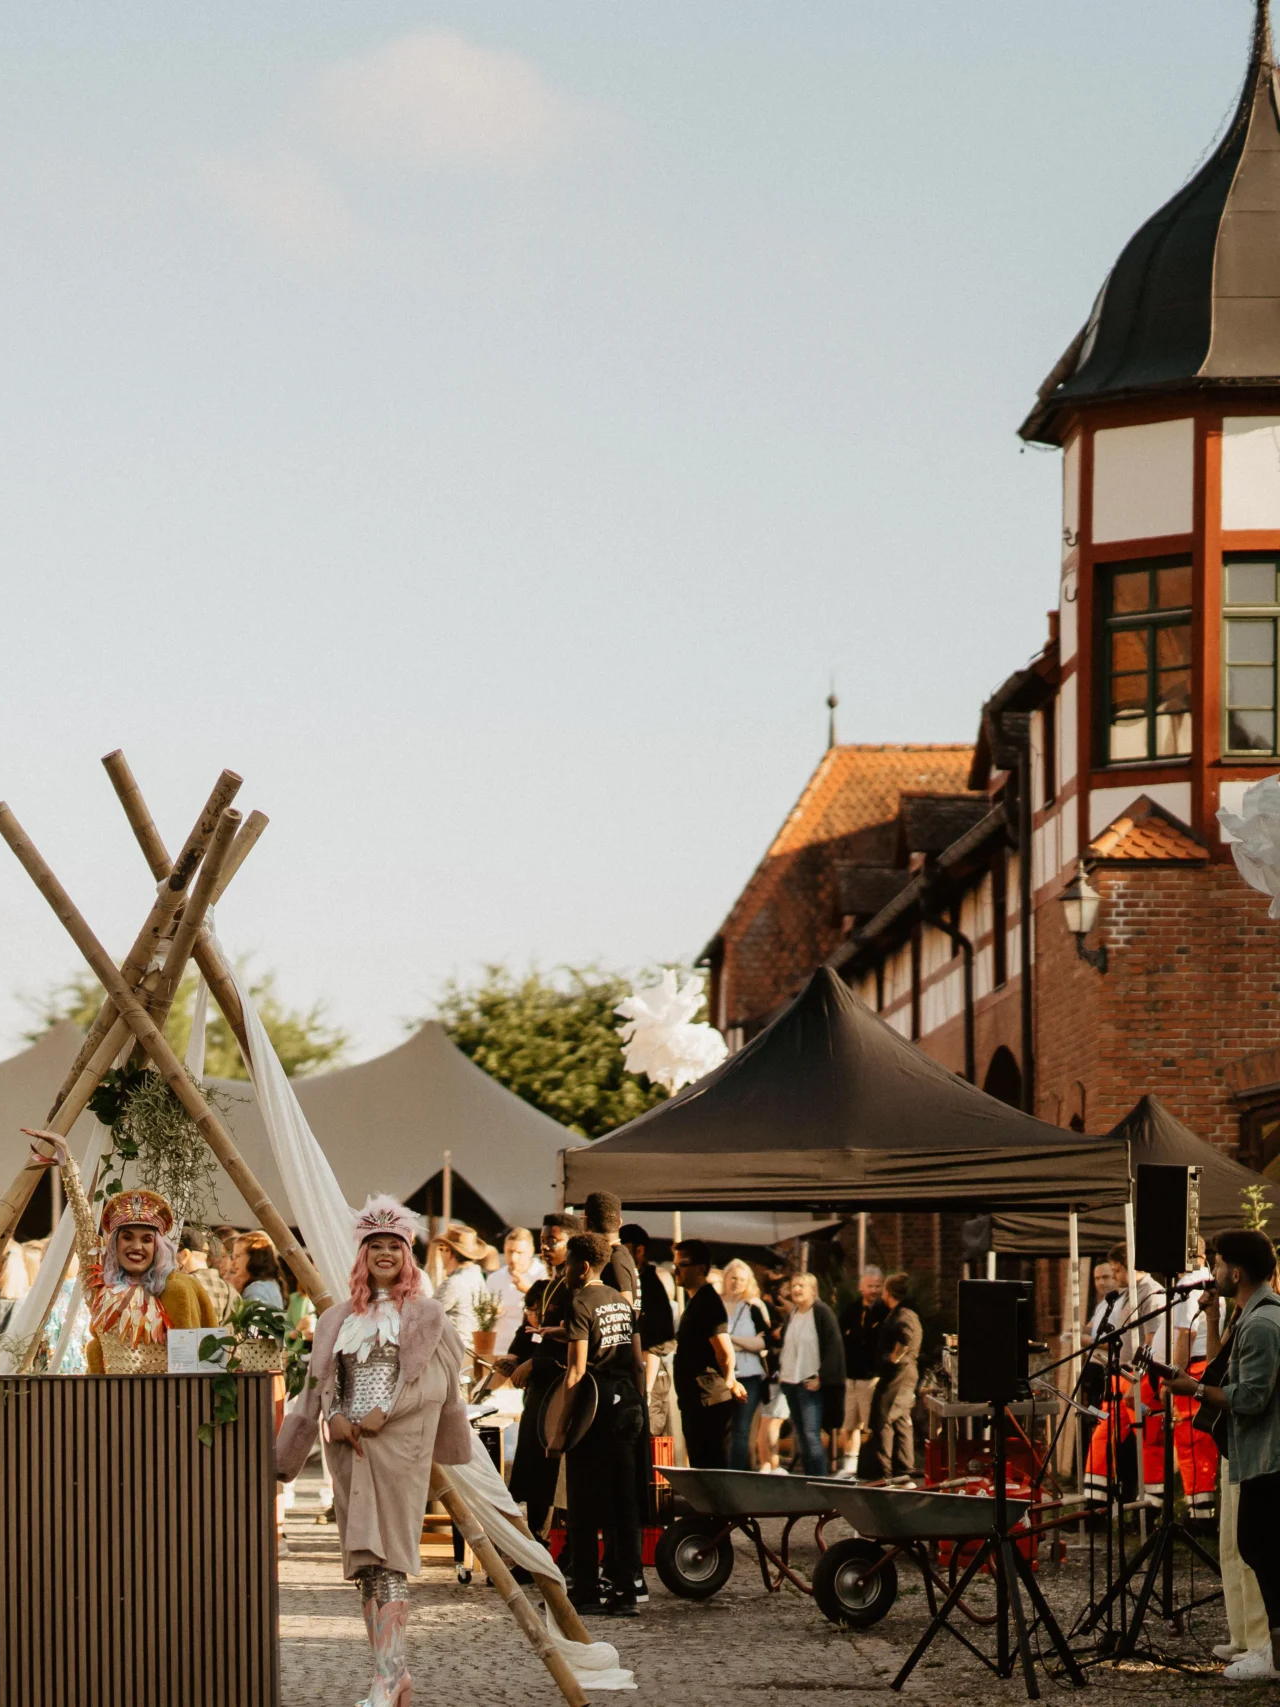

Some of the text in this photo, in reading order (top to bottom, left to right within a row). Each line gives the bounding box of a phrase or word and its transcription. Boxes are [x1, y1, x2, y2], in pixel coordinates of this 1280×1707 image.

[599, 1313, 631, 1326] A CERING
[600, 1325, 611, 1335] WE
